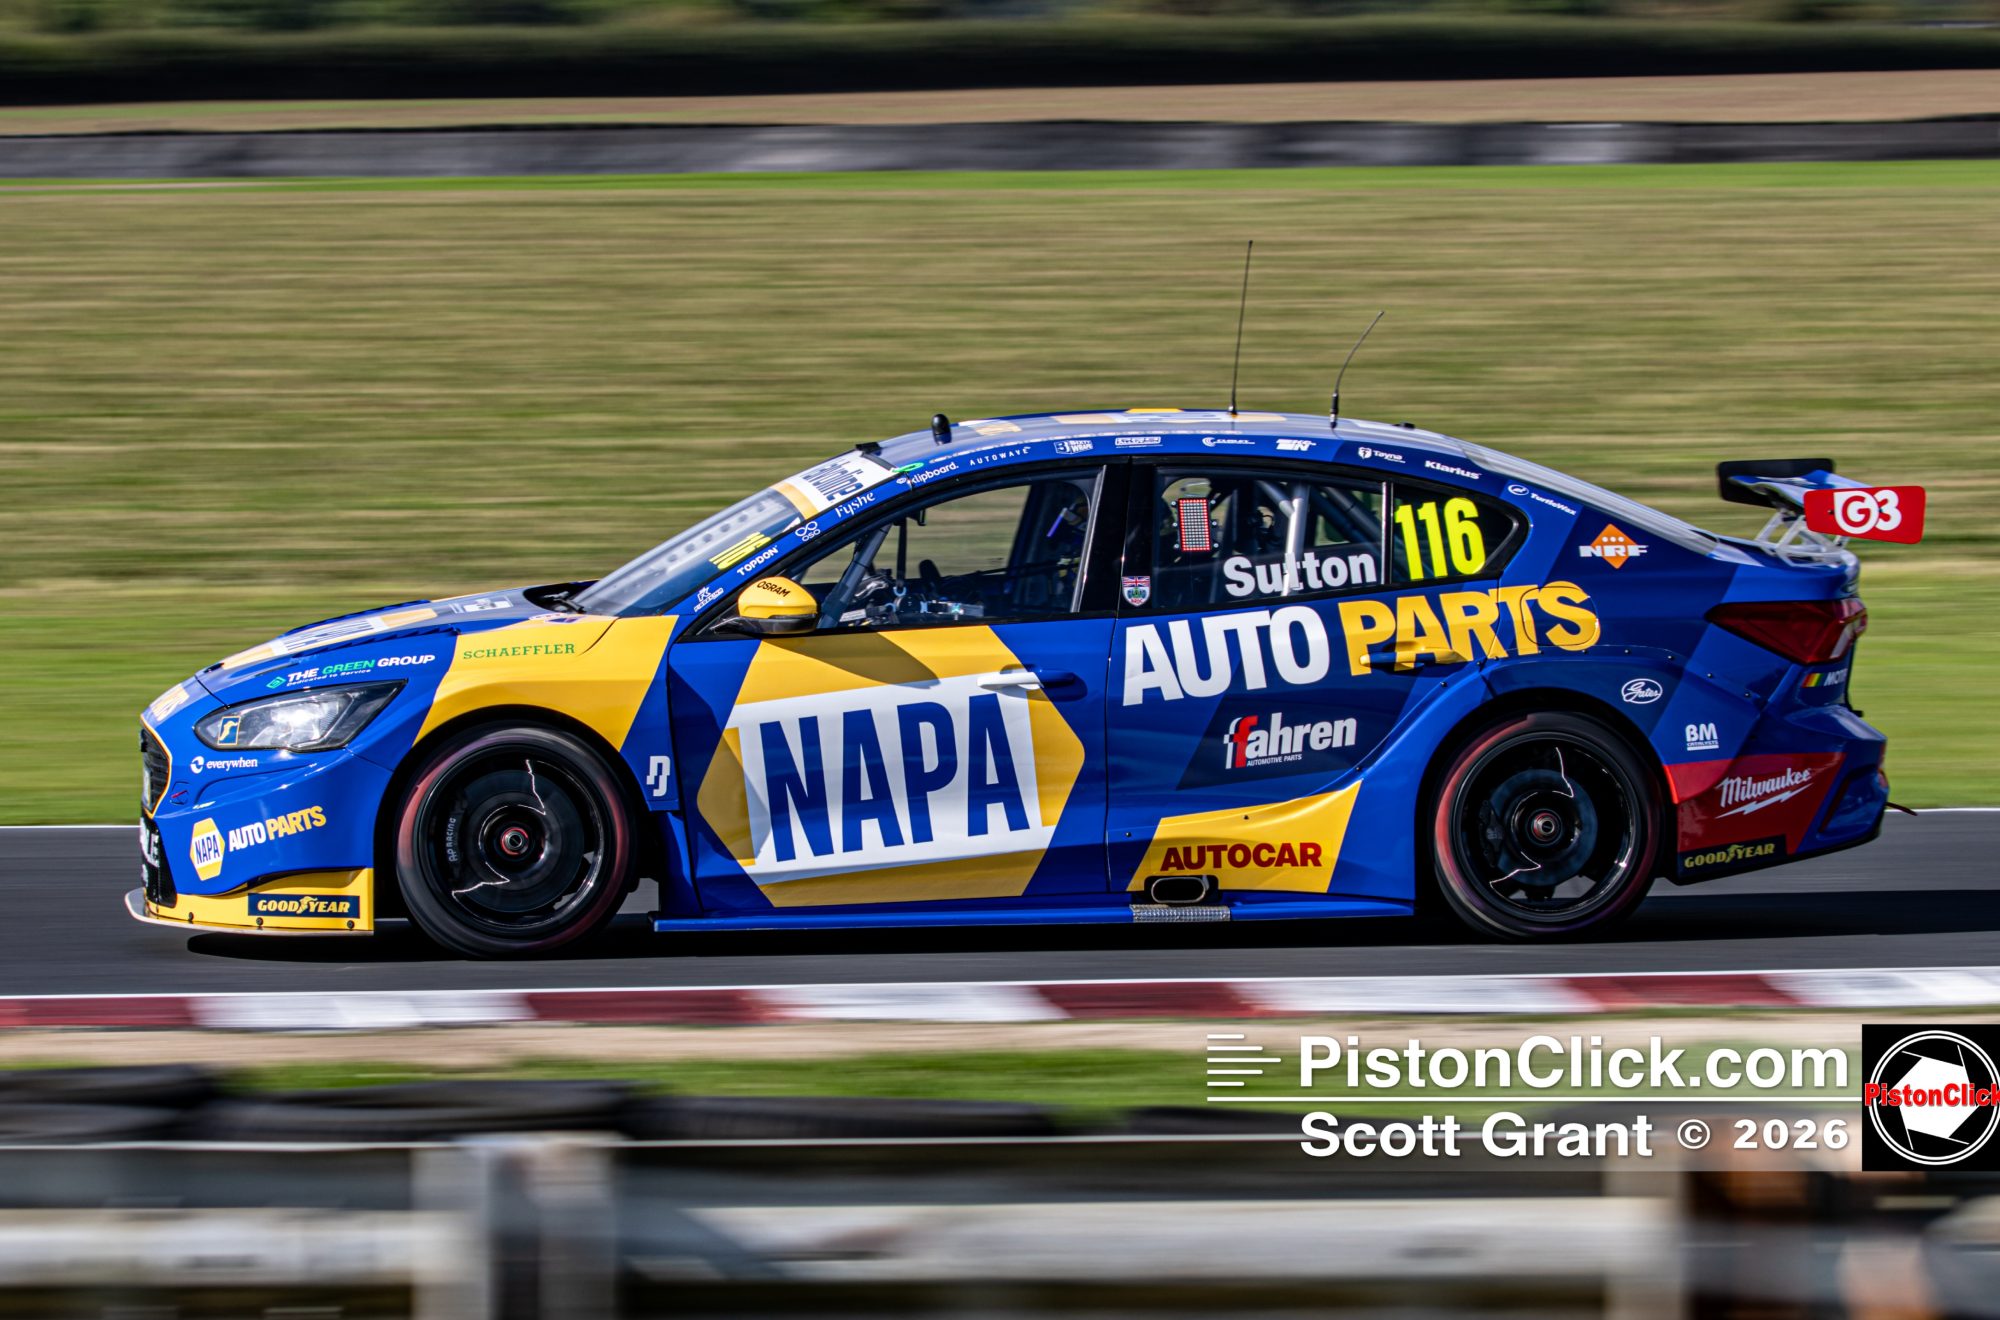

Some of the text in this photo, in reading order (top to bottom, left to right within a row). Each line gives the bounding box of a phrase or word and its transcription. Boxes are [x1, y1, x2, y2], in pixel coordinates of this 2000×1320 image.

[970, 447, 1029, 466] AUTOWAVE
[1373, 450, 1402, 461] Tayna
[801, 461, 863, 502] alvoline
[1425, 460, 1480, 480] Klarius
[835, 492, 875, 518] Fyshe
[1394, 497, 1485, 581] 116
[1579, 544, 1648, 558] NRF
[737, 547, 778, 576] TOPDON
[1224, 551, 1377, 597] Sutton
[757, 581, 790, 598] OSRAM
[463, 643, 575, 660] SCHAEFFLER
[1122, 581, 1600, 706] AUTO PARTS
[286, 674, 327, 687] Dedicated
[340, 669, 371, 677] Service
[287, 654, 435, 682] THE GREEN GROUP
[1223, 712, 1357, 769] fahren
[1685, 723, 1718, 742] BM
[206, 757, 258, 771] everywhen
[1246, 754, 1302, 767] AUTOMOTIVE PARTS
[759, 693, 1030, 862] NAPA
[1714, 768, 1813, 808] Milwaukee
[195, 834, 220, 864] NAPA
[228, 822, 267, 852] AUTO
[266, 805, 327, 840] PARTS
[1160, 842, 1322, 871] AUTOCAR
[1684, 842, 1774, 868] GOODYEAR
[258, 897, 350, 914] GOODYEAR
